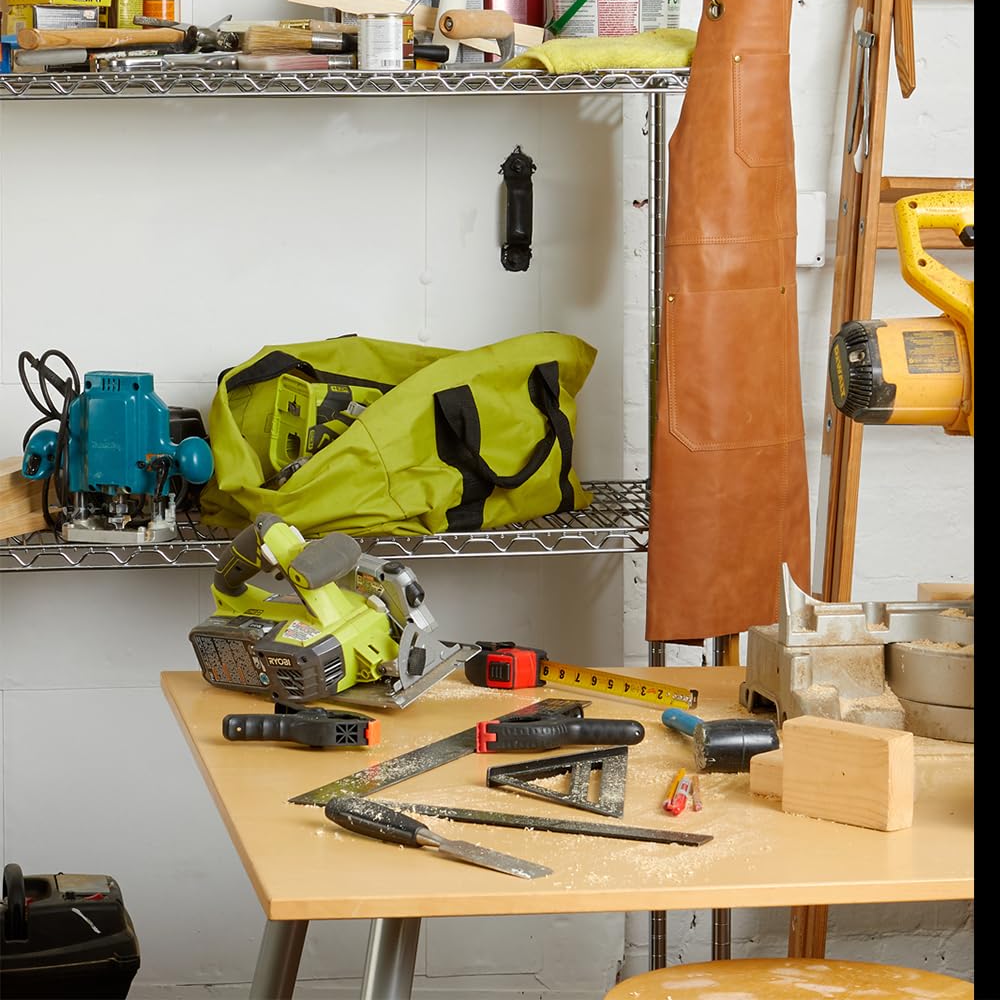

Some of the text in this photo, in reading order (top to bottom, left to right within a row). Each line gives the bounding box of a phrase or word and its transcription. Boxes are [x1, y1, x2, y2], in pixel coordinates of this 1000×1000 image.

[267, 656, 292, 667] RYOBI
[543, 665, 549, 676] 9
[559, 669, 566, 679] 8
[574, 672, 581, 682] 7
[591, 675, 598, 686] 6
[607, 679, 614, 690] 5
[624, 683, 631, 693] 4
[640, 686, 647, 696] 3
[657, 689, 664, 700] 2
